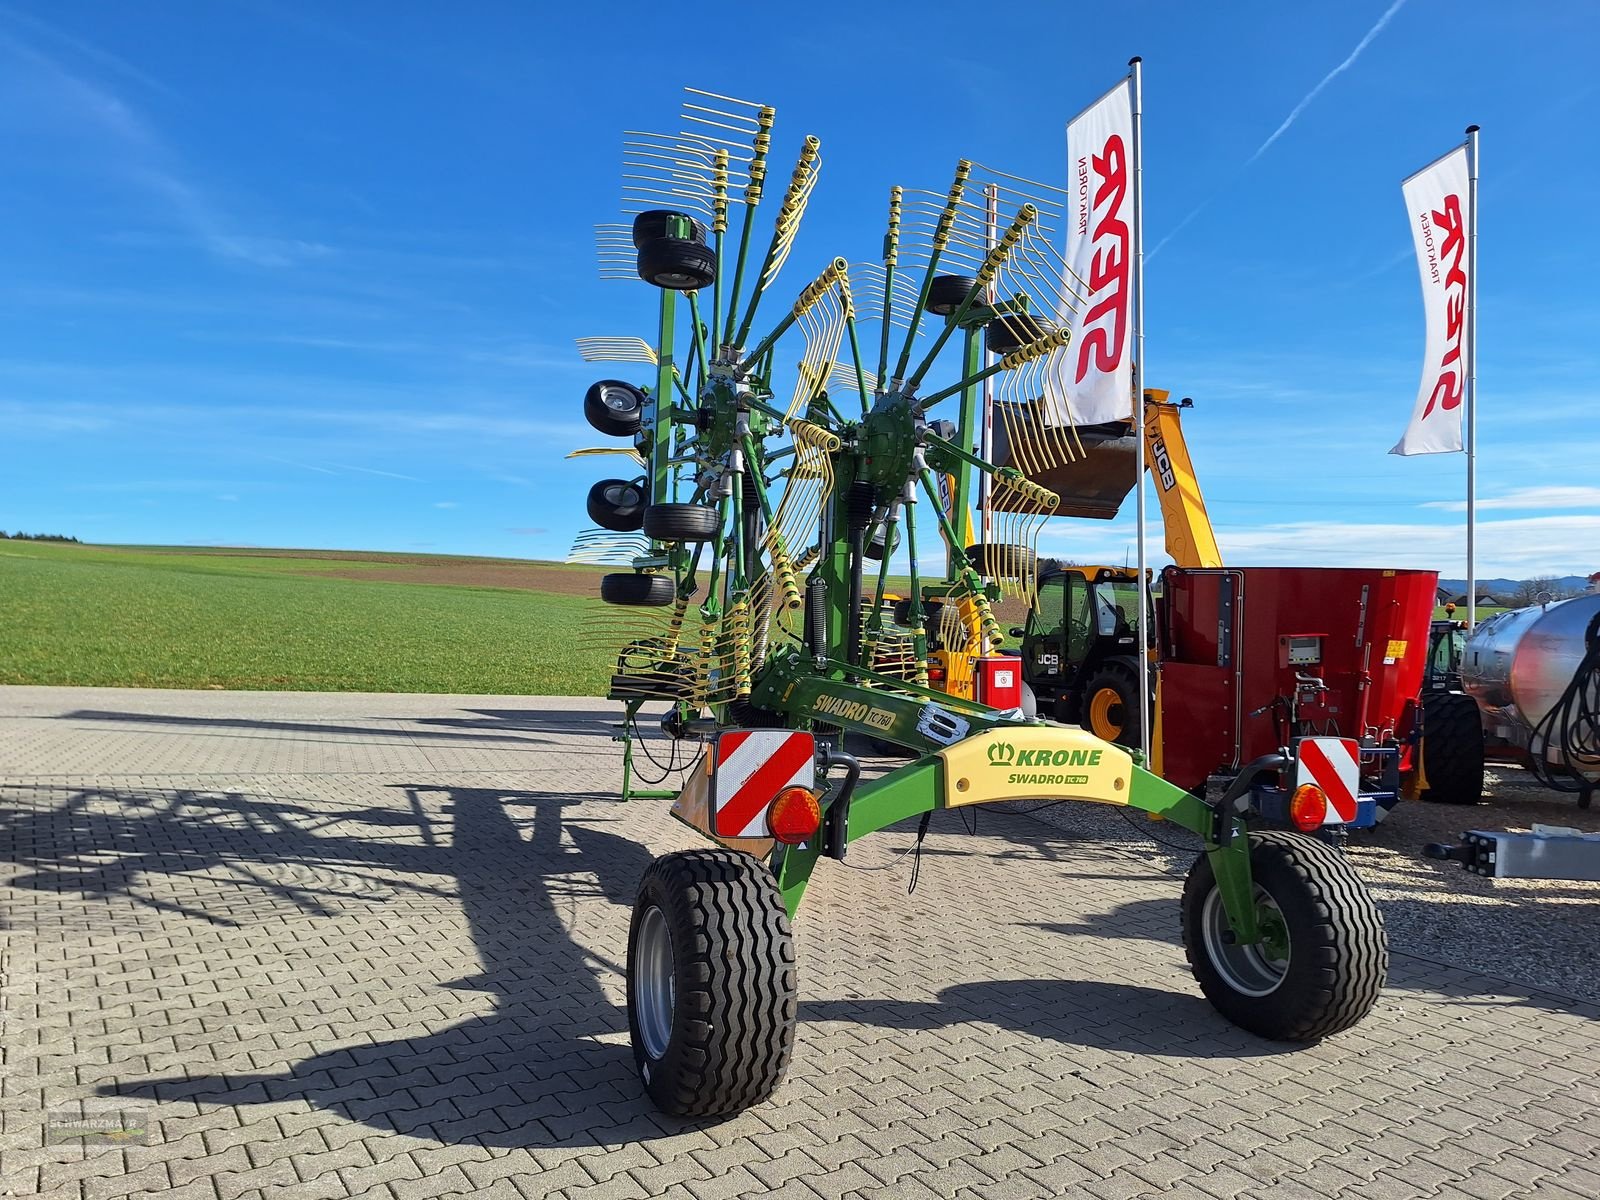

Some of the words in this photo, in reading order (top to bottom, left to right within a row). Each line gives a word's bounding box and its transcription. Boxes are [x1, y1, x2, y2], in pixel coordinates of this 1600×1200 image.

[1153, 441, 1175, 491] JCB
[1038, 654, 1059, 665] JCB
[813, 694, 868, 721] SWADRO
[1016, 750, 1103, 766] KRONE
[1008, 774, 1064, 784] SWADRO
